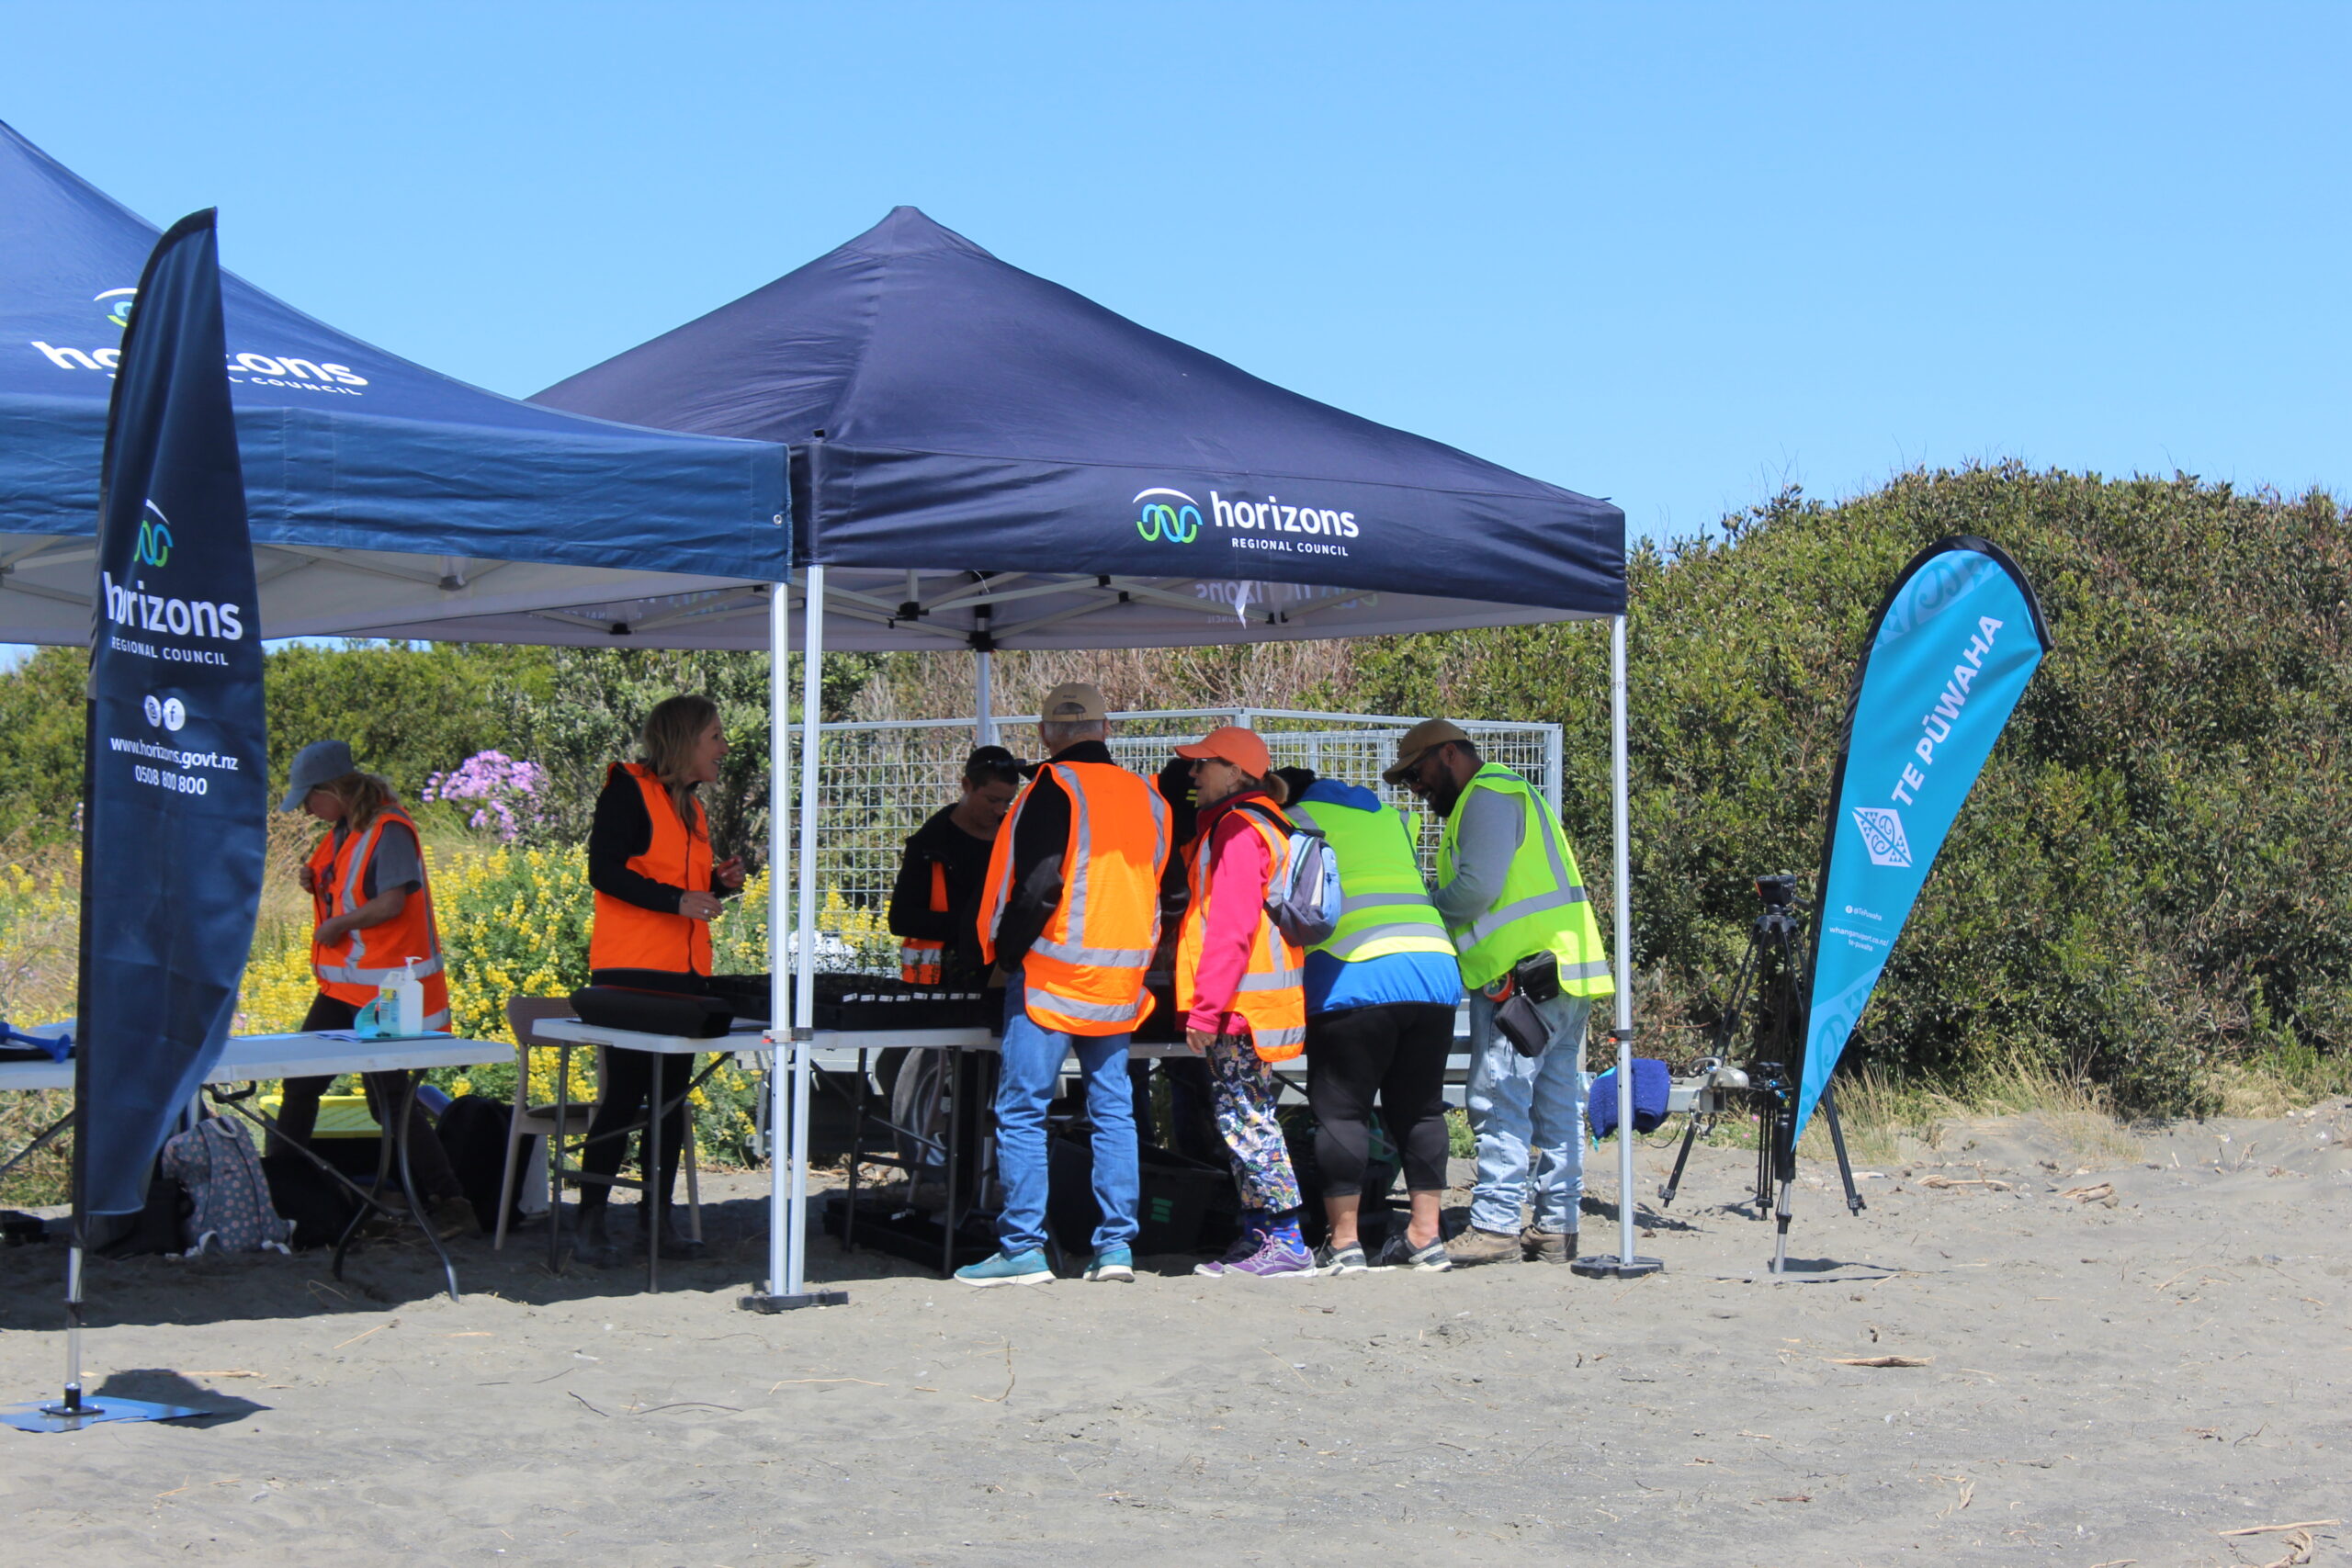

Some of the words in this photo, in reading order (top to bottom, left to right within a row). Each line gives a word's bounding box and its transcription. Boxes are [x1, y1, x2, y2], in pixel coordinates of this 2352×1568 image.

[251, 377, 363, 396] COUNCIL
[1210, 491, 1359, 537] horizons
[1232, 537, 1293, 552] REGIONAL
[1297, 542, 1349, 556] COUNCIL
[103, 571, 243, 640] horizons
[111, 637, 158, 660] REGIONAL
[163, 648, 229, 666] COUNCIL
[1891, 761, 1925, 807] TE
[1915, 615, 2004, 765] PŪWAHA
[110, 738, 239, 771] www.horizons.govt.nz
[135, 765, 159, 785] 0508
[162, 771, 176, 790] 800
[178, 775, 208, 795] 800
